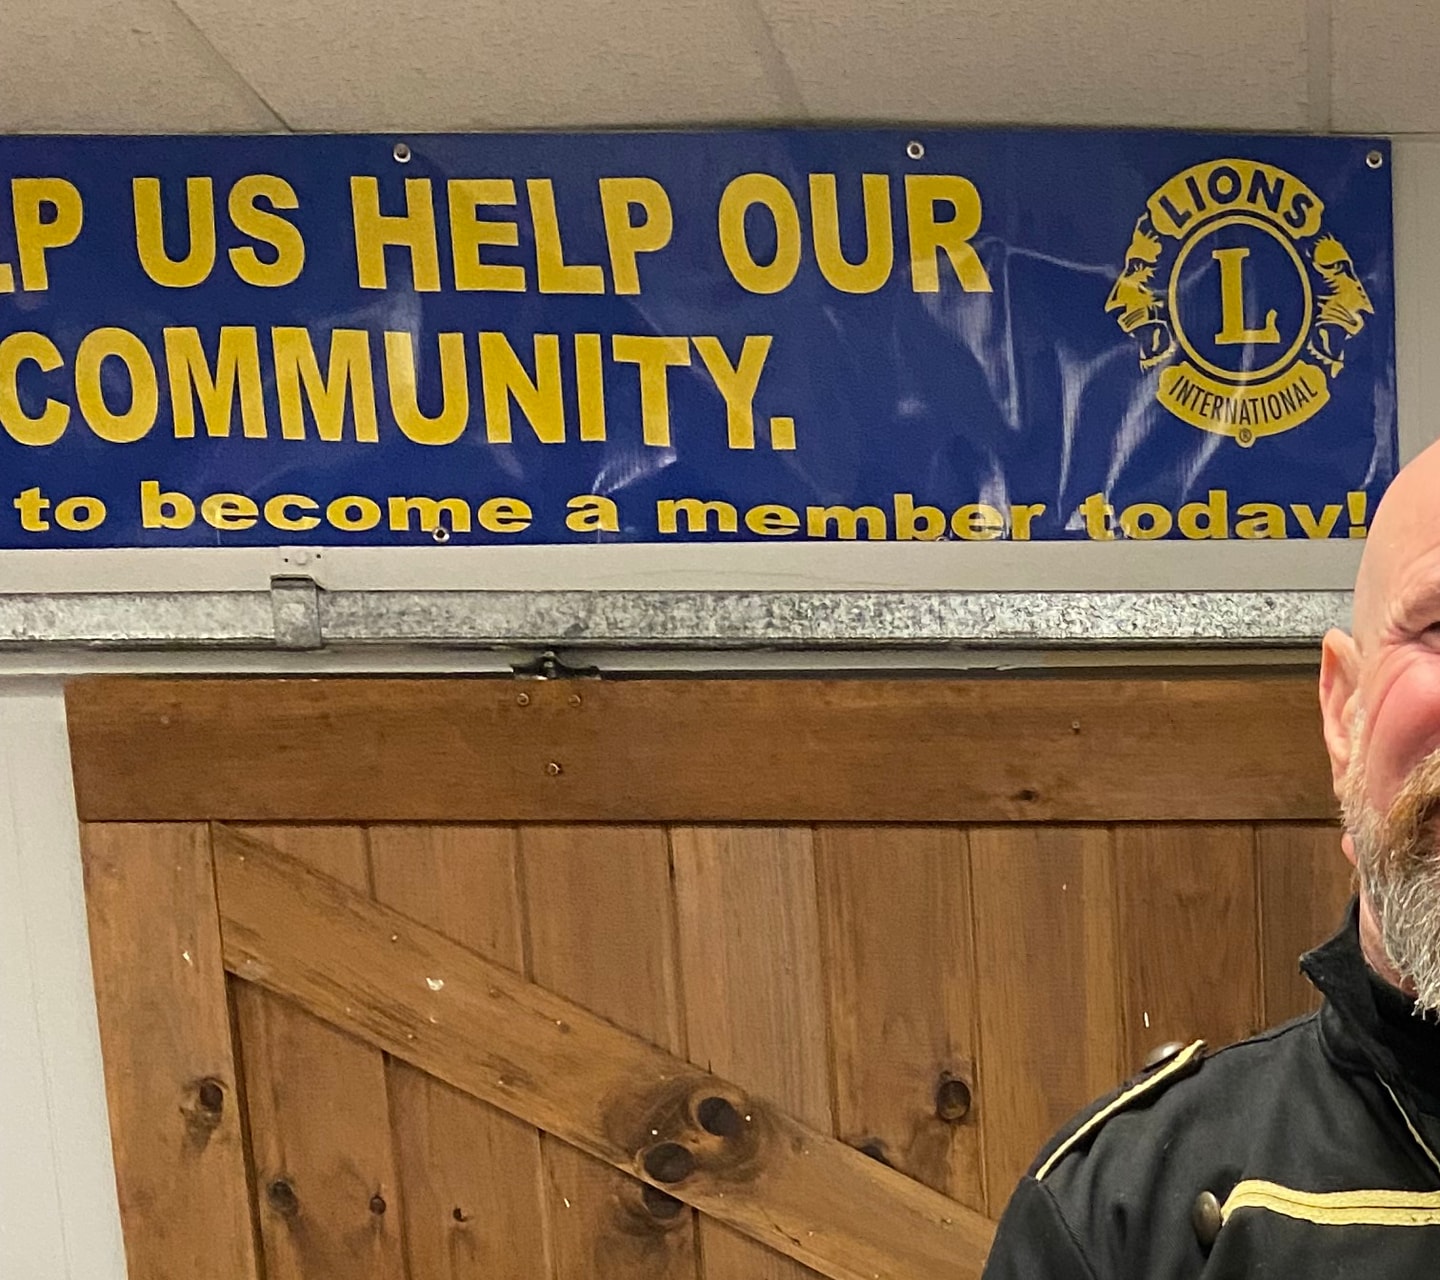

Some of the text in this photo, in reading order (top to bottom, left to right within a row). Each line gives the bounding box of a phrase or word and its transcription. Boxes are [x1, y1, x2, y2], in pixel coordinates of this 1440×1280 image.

[0, 172, 993, 295] P US HELP OUR
[1158, 165, 1315, 230] LIONS
[1212, 247, 1281, 345] L
[0, 326, 797, 450] COMMUNITY.
[1168, 375, 1318, 426] INTERNATIONAL
[14, 481, 1368, 541] to become a member today!
